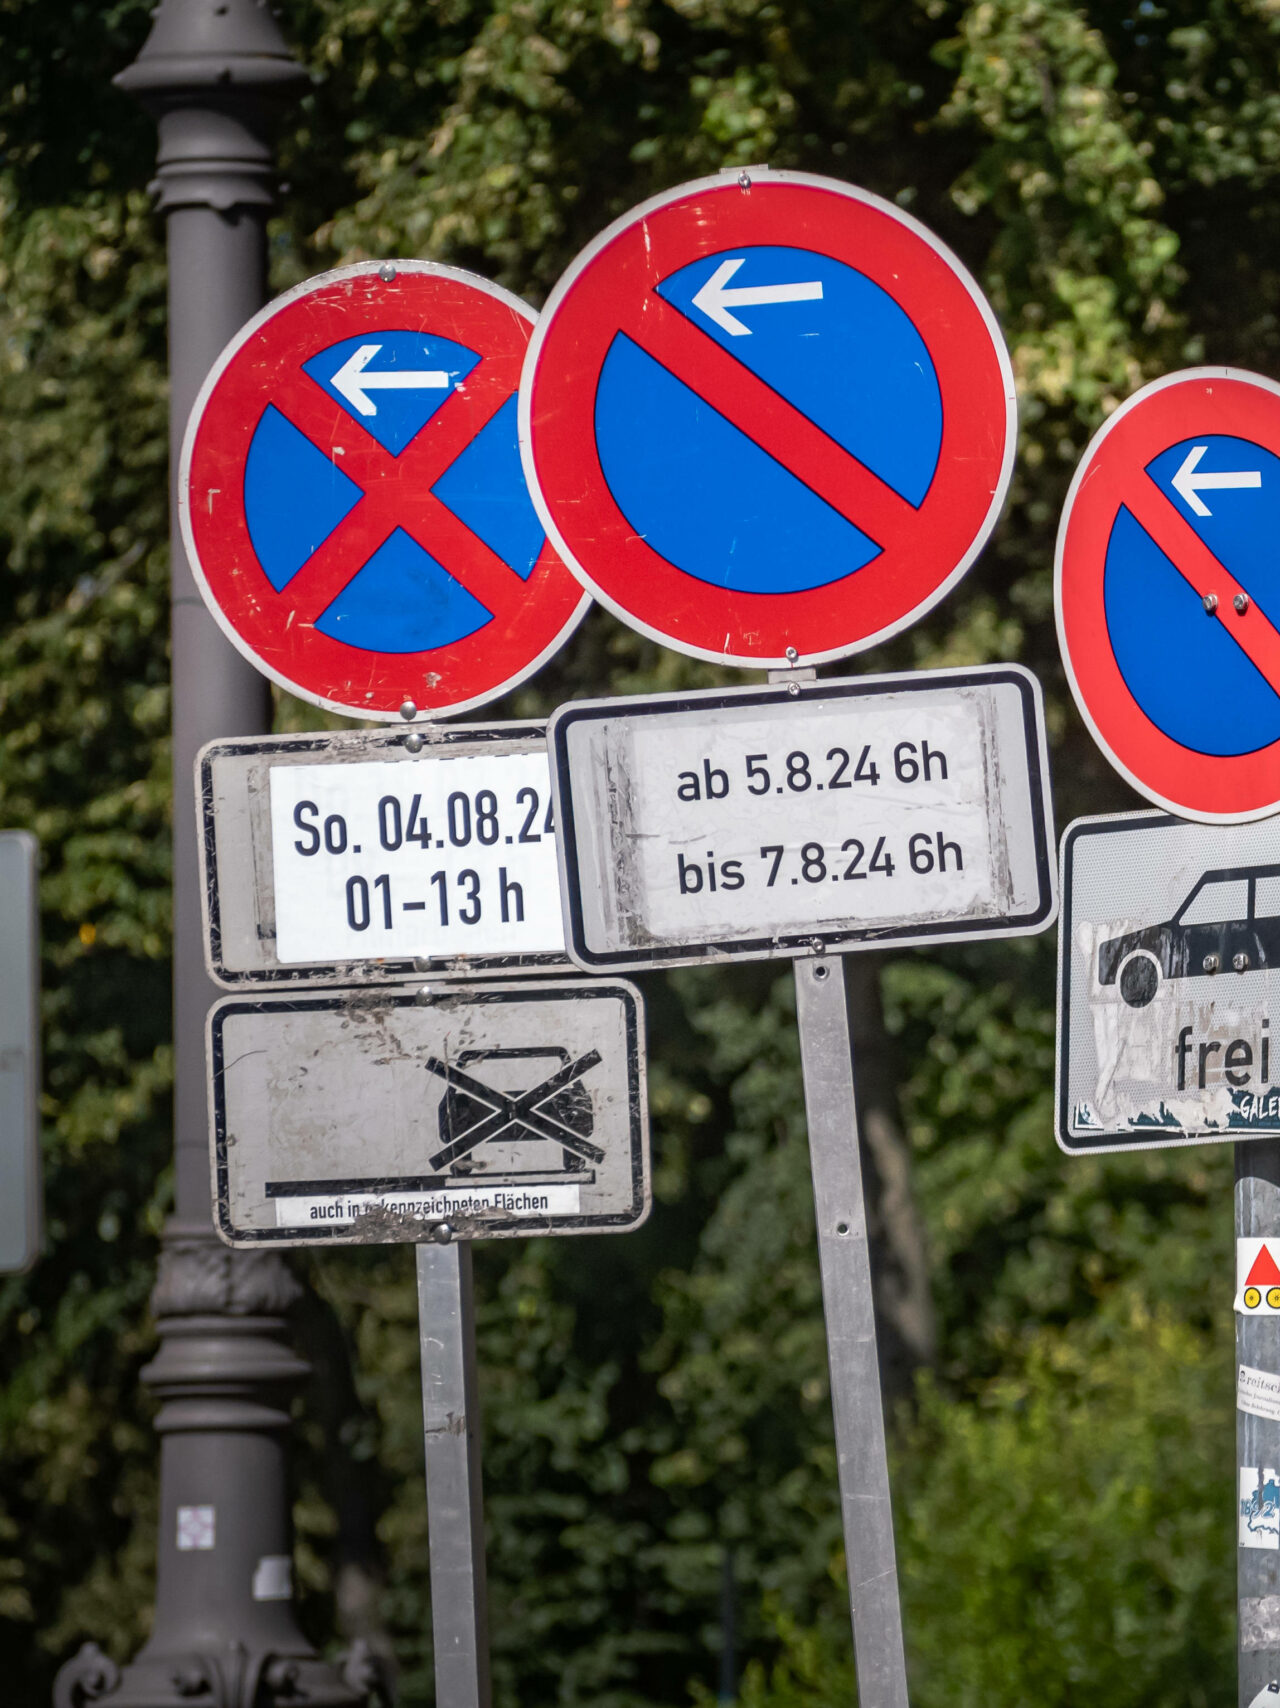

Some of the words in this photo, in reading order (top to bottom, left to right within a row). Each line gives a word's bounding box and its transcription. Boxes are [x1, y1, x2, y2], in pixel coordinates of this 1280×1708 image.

[677, 758, 730, 801] ab
[746, 745, 881, 796] 5.8.24
[893, 739, 949, 783] 6h
[293, 799, 362, 857] So.
[677, 850, 746, 895] bis
[760, 836, 896, 888] 7.8.24
[908, 831, 964, 874] 6h
[499, 866, 525, 923] h
[1175, 1018, 1270, 1091] frei
[310, 1200, 343, 1219] auch
[347, 1200, 360, 1217] in
[494, 1193, 549, 1211] Flächen
